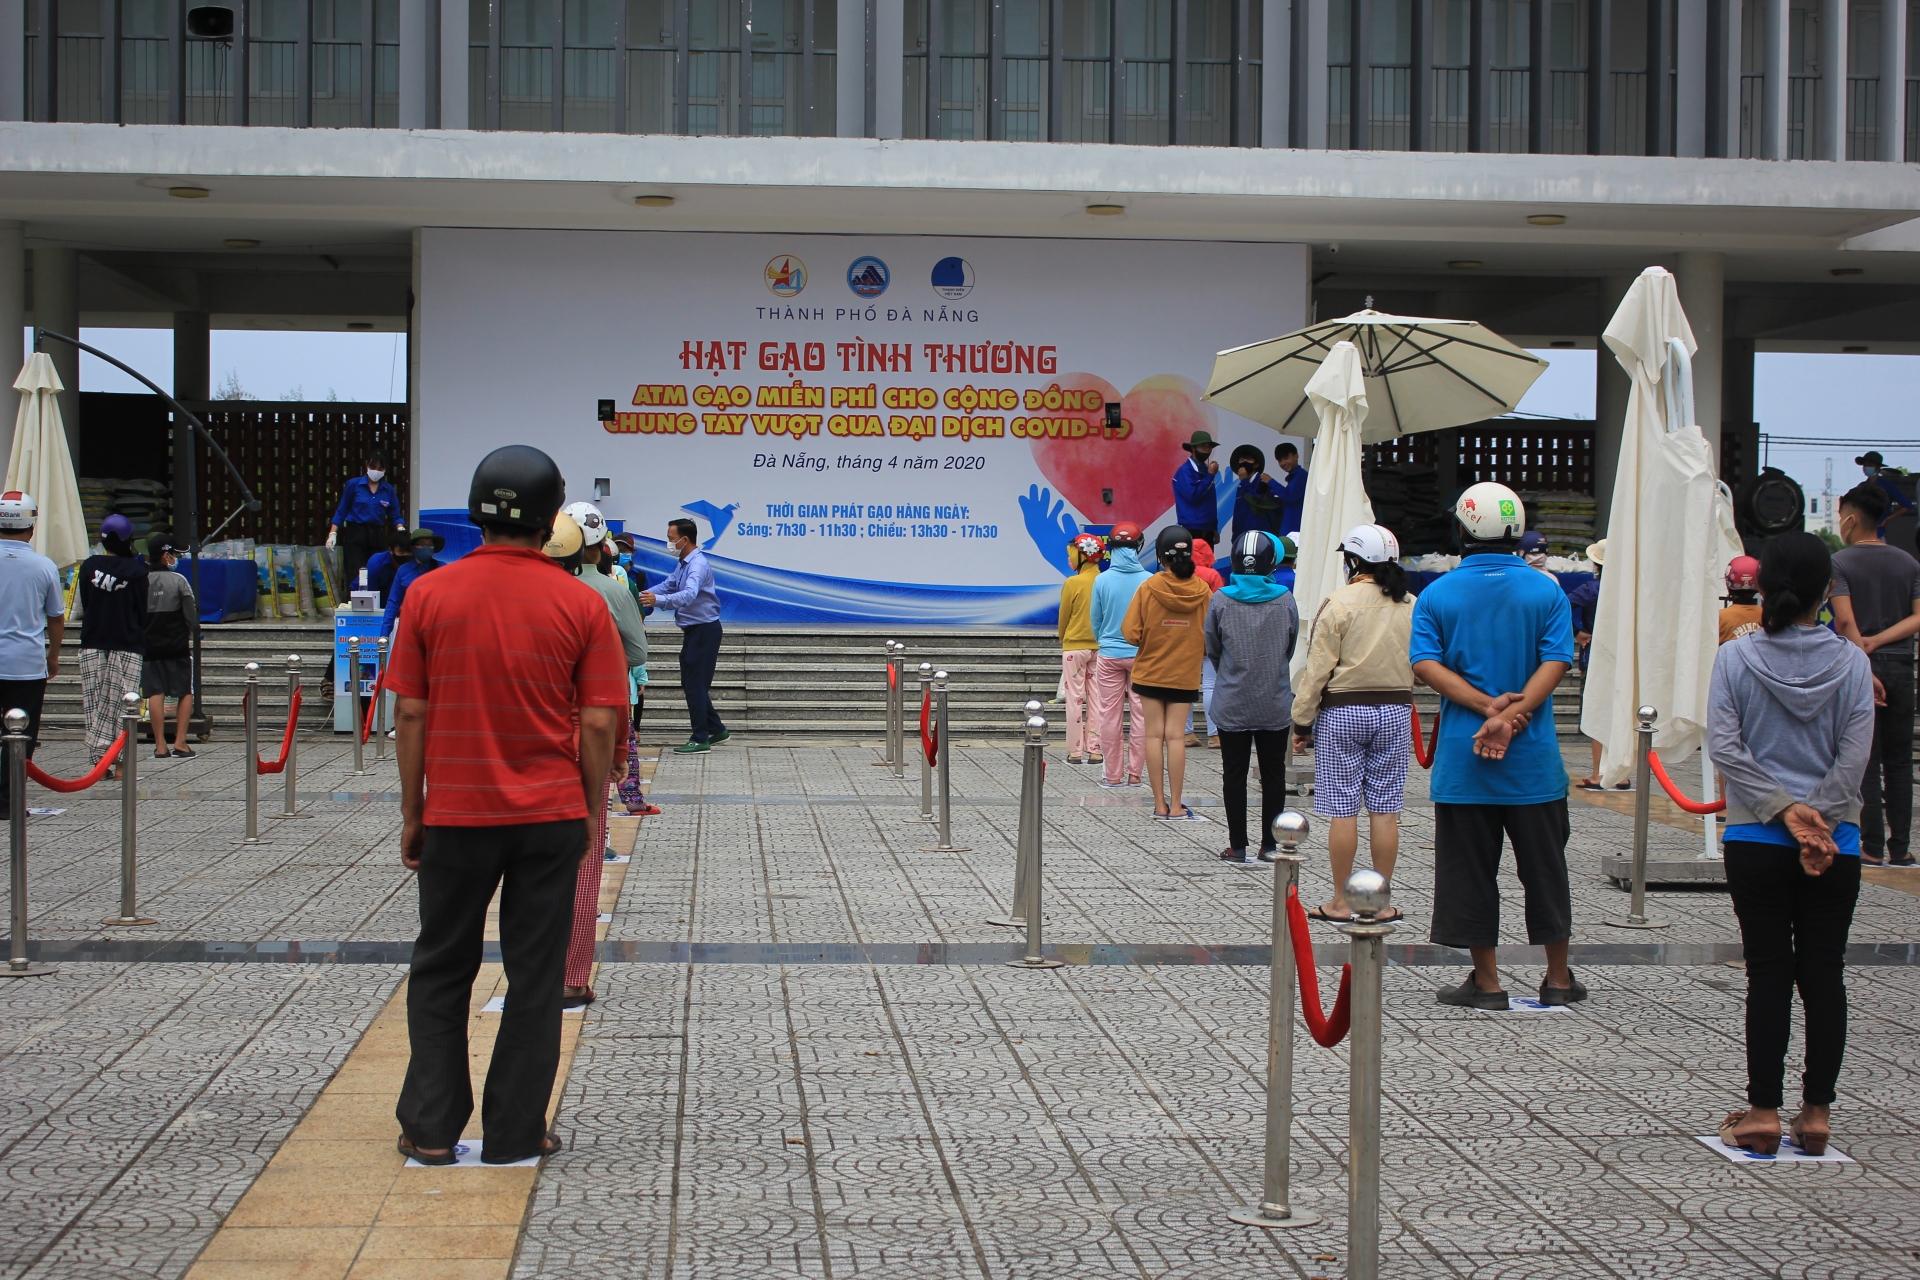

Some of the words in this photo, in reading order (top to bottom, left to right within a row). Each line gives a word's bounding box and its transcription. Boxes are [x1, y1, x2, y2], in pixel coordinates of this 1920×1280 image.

[756, 304, 824, 320] THÀNH
[836, 304, 877, 321] PHỐ
[887, 305, 912, 321] ĐÀ
[923, 305, 979, 322] NẴNG
[678, 340, 747, 377] HẠT
[758, 341, 826, 378] GẠO
[836, 336, 912, 373] TÌNH
[923, 340, 1057, 374] THƯƠNG
[632, 384, 688, 406] ATM
[693, 385, 751, 411] GẠO
[756, 379, 824, 407] MIỄN
[831, 383, 876, 408] PHÍ
[882, 387, 938, 409] CHO
[943, 384, 1019, 414] CỘNG
[1023, 384, 1104, 412] ĐỒNG
[702, 413, 749, 435] TAY
[750, 414, 822, 440] VƯỢT
[827, 414, 884, 437] QUA
[888, 415, 935, 441] ĐẠI
[942, 415, 1004, 442] DỊCH
[753, 453, 776, 468] Đà
[782, 452, 830, 472] Nẵng,
[836, 455, 882, 473] tháng
[887, 455, 898, 469] 4
[903, 455, 938, 470] năm
[943, 456, 986, 470] 2020
[766, 501, 794, 518] THỜI
[798, 504, 828, 518] GIAN
[832, 502, 864, 519] PHÁT
[867, 504, 893, 522] GẠO
[896, 503, 931, 519] HÀNG
[934, 503, 970, 519] NGÀY:
[737, 522, 772, 538] Sáng:
[776, 523, 806, 537] 7h30
[819, 523, 857, 537] 11h30
[867, 521, 907, 537] Chiều:
[911, 524, 948, 537] 13h30
[961, 525, 998, 538] 17h30
